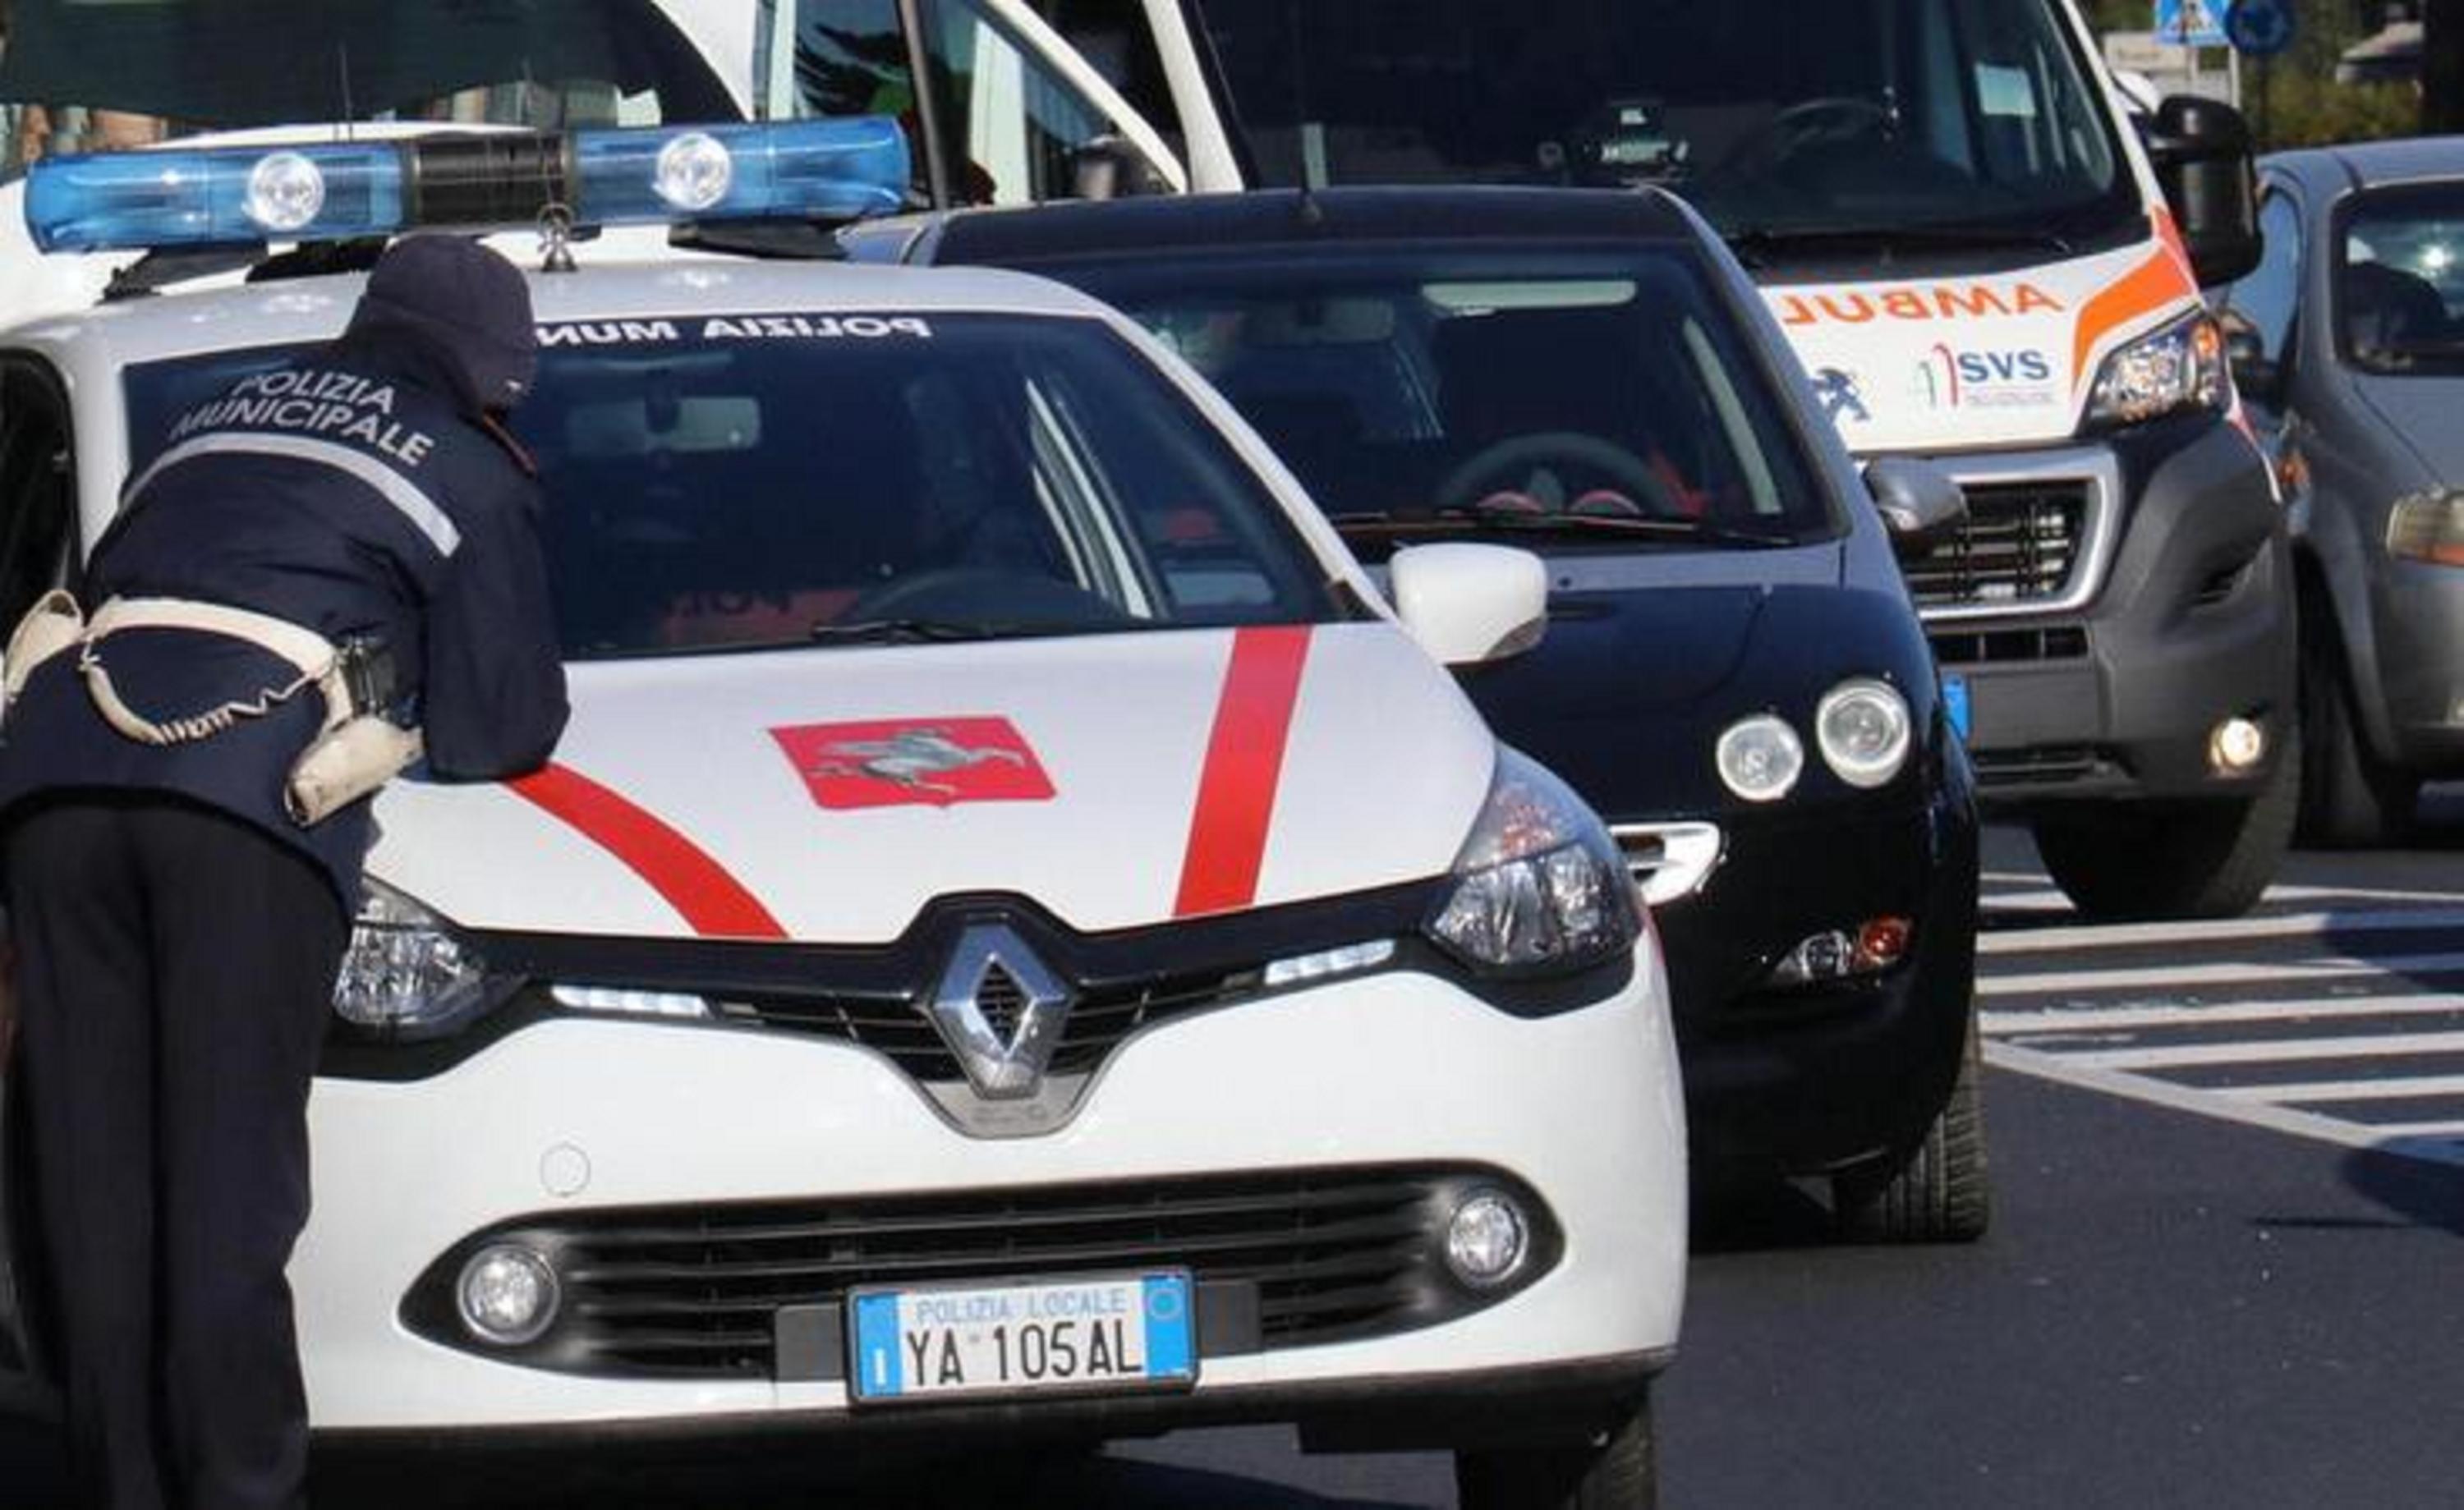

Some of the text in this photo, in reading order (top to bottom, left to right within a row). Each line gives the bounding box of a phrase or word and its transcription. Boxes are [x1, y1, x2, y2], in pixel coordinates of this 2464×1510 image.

[1958, 350, 2050, 383] SVS
[232, 372, 393, 414] POLIZIA
[168, 398, 434, 466] MUNICIPALE
[917, 1288, 1127, 1324] POLIZIA LOCALE
[907, 1327, 964, 1386] YA
